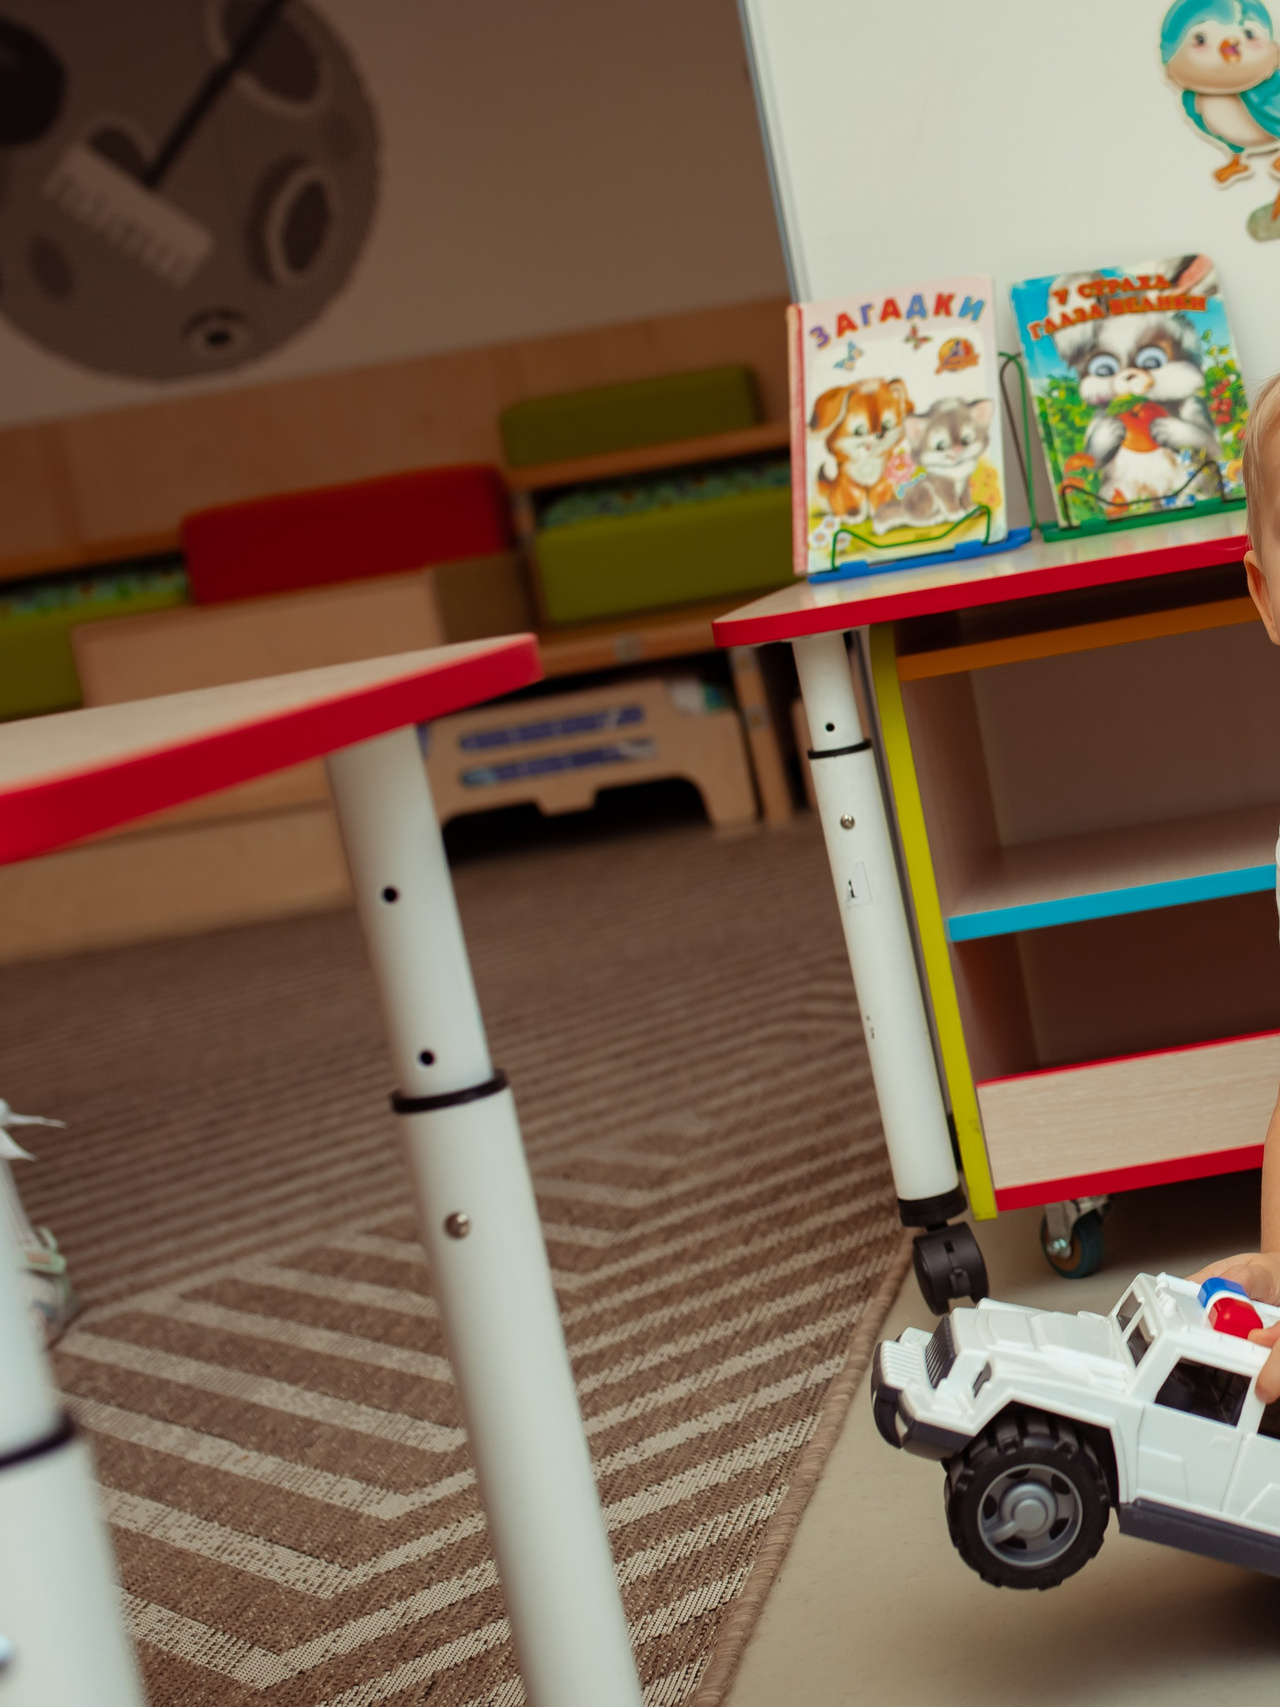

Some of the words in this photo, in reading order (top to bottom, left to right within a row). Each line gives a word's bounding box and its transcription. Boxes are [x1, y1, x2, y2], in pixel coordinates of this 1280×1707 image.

[1052, 288, 1068, 305] У
[1077, 273, 1173, 299] СТРАХА
[809, 292, 985, 348] ЗАГАДКИ
[1028, 304, 1105, 340] ГЛАЗА
[1108, 294, 1207, 316] ВЕЛИКИ
